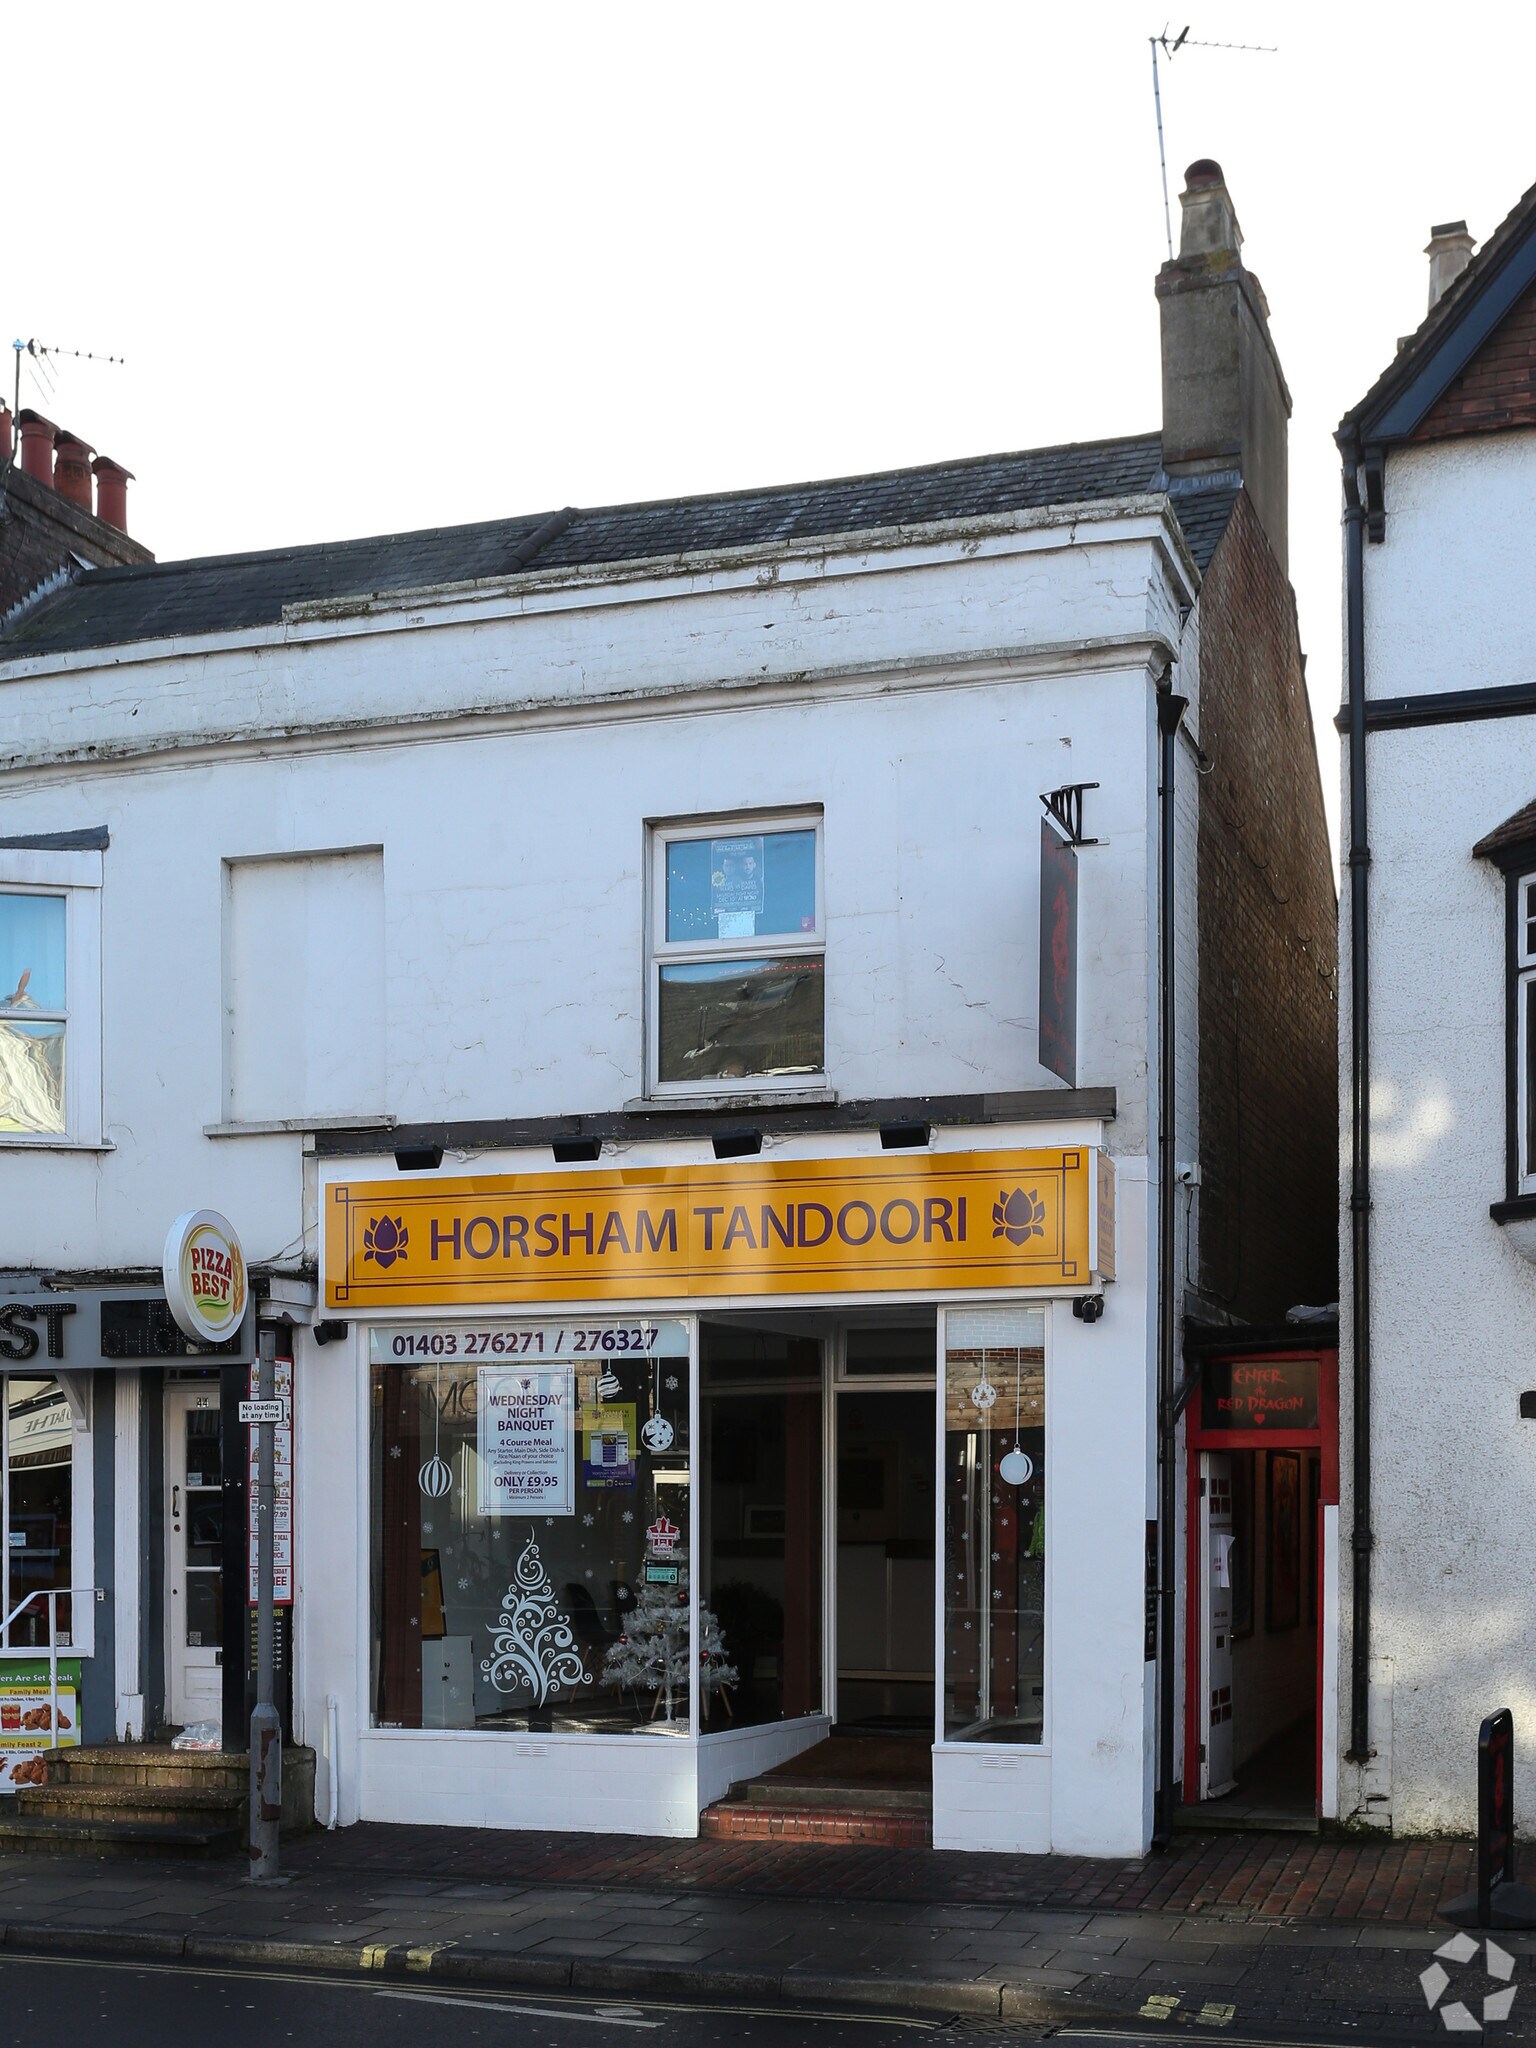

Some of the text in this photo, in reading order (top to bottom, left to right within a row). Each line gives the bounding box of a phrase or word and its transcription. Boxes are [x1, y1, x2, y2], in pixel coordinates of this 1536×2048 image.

[430, 1196, 967, 1261] HORSHAM TANDOORI
[191, 1247, 232, 1280] PIZZA
[191, 1272, 230, 1301] BEST
[0, 1303, 77, 1360] ST
[392, 1328, 659, 1356] 01403 276271 / 276327
[1233, 1367, 1288, 1384] ENTER
[254, 1404, 279, 1412] loading
[490, 1395, 562, 1406] WEDNESDAY
[1217, 1396, 1303, 1412] RED DRAGON
[508, 1408, 545, 1418] NIGHT
[498, 1420, 554, 1432] BANQUET
[506, 1438, 532, 1446] Course
[534, 1438, 552, 1446] Meal
[494, 1476, 558, 1487] ONLY £9.95
